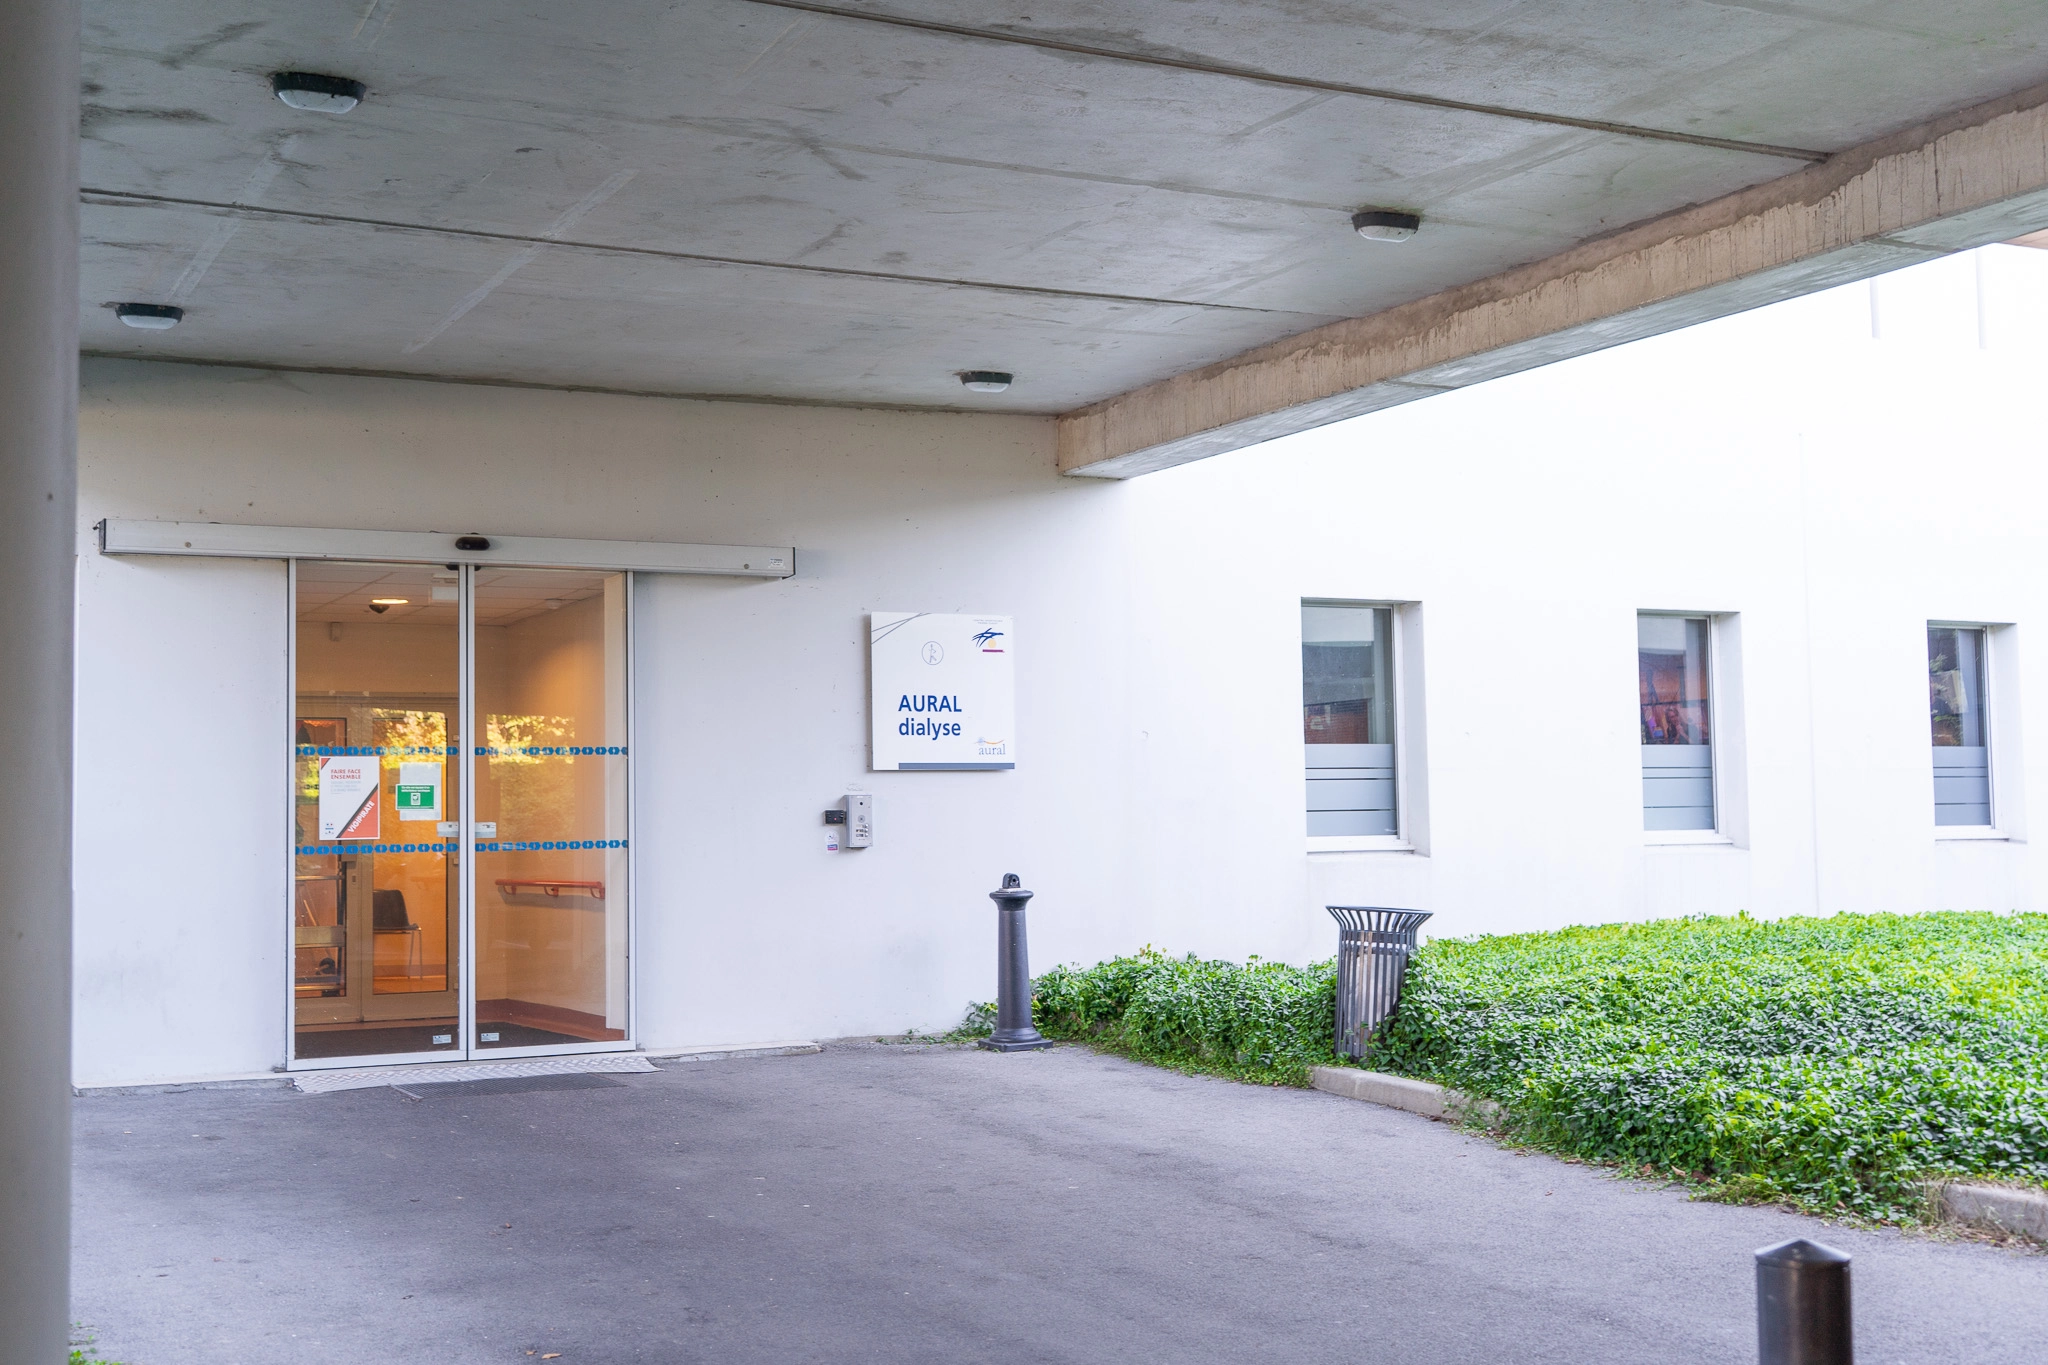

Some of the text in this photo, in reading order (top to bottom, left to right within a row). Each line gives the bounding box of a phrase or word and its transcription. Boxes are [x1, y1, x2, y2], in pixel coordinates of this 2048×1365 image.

[898, 694, 962, 712] AURAL
[898, 717, 961, 741] dialyse
[978, 743, 1006, 755] aural
[347, 800, 375, 833] VIGIPIRATE
